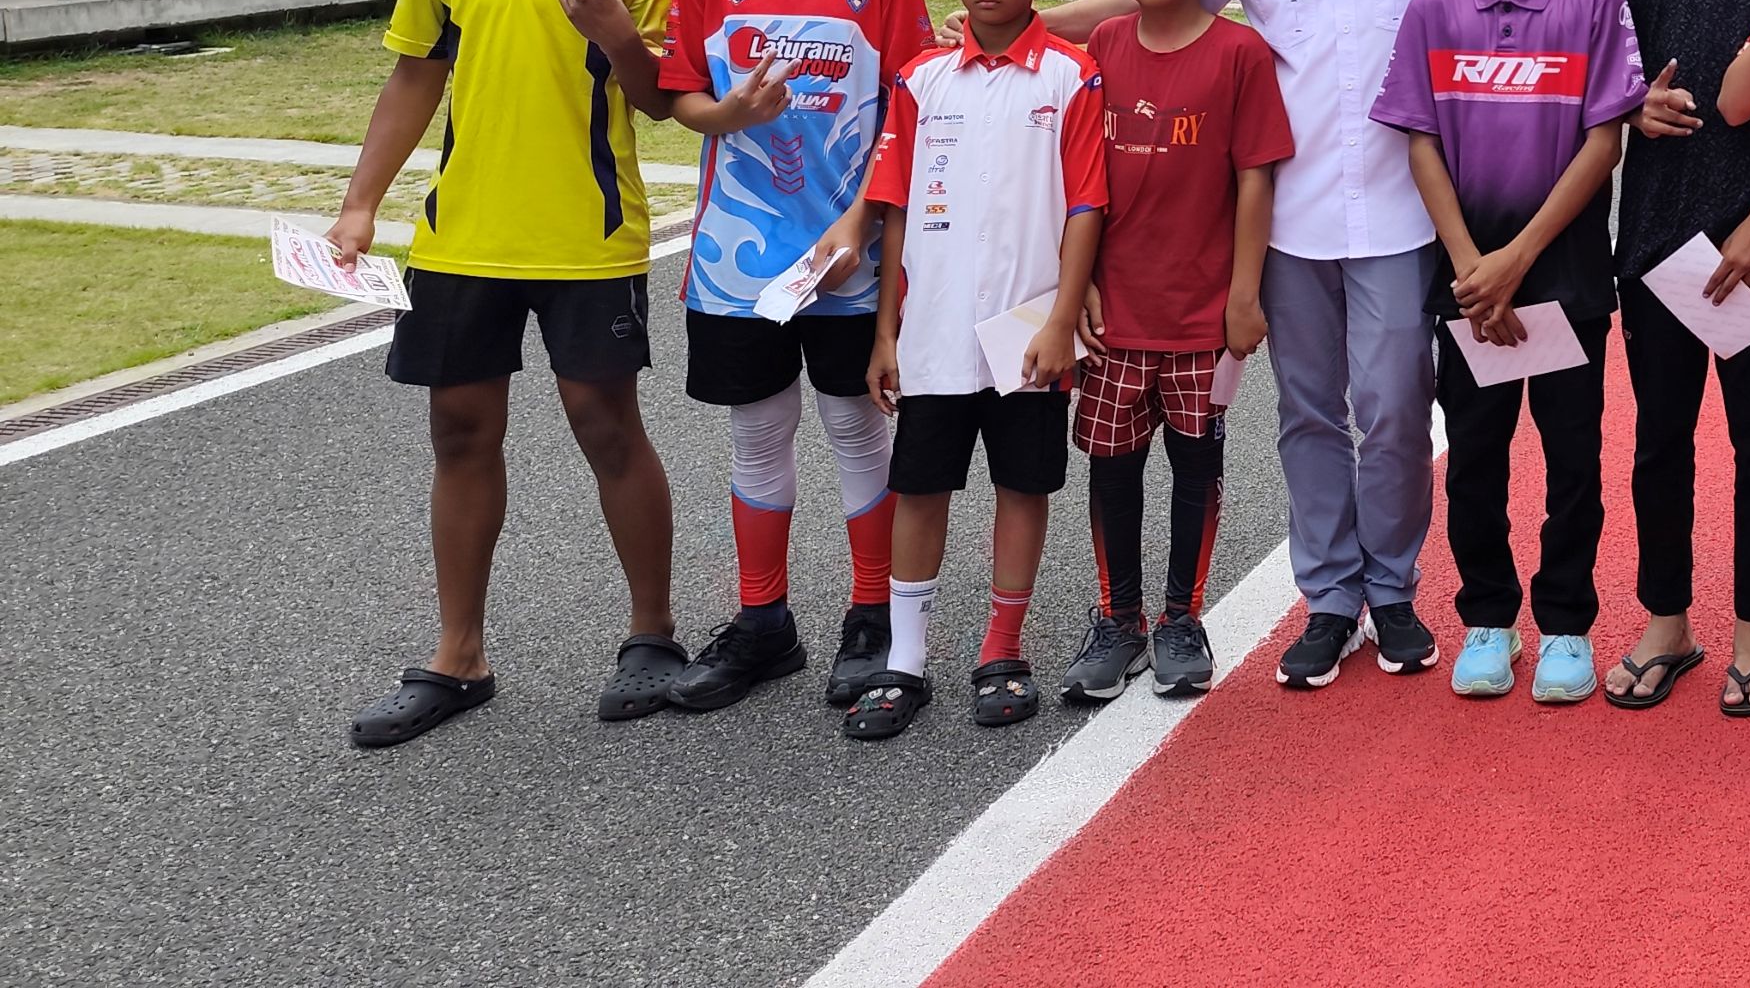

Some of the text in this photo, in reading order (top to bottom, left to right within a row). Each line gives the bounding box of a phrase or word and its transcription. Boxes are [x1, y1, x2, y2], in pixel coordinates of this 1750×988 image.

[749, 35, 854, 64] Laturama
[788, 58, 850, 81] group
[1452, 54, 1568, 85] RMF
